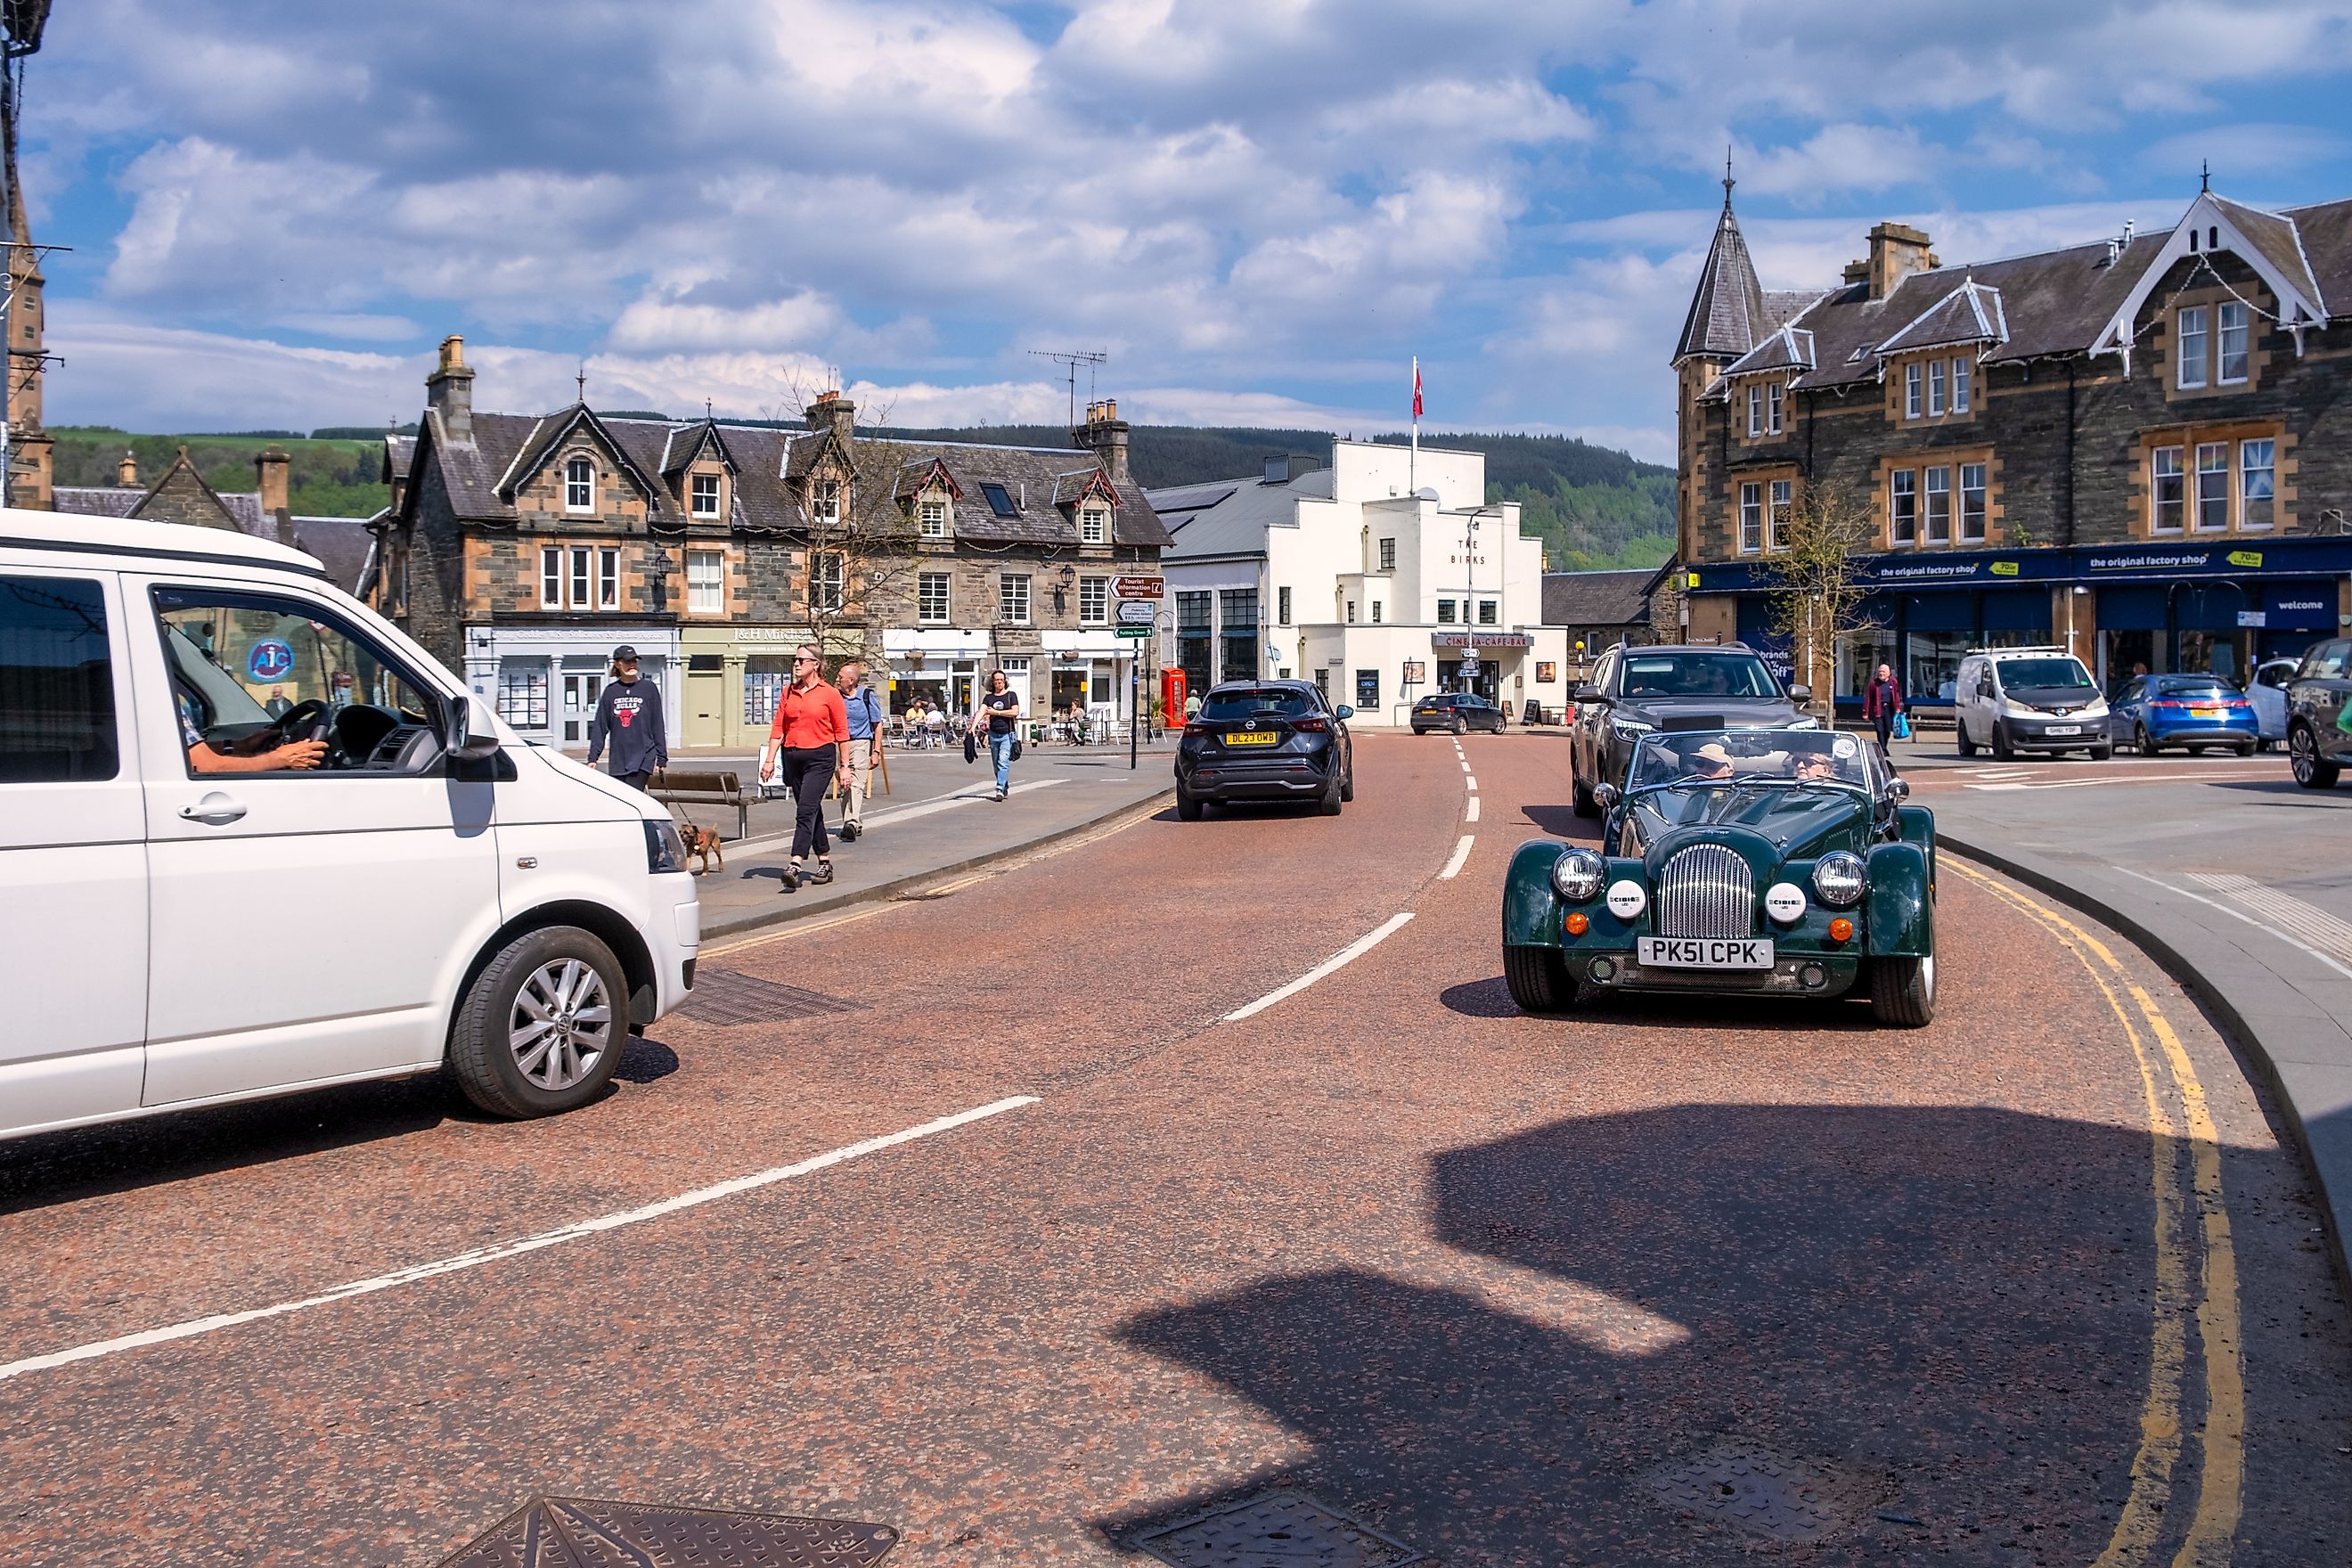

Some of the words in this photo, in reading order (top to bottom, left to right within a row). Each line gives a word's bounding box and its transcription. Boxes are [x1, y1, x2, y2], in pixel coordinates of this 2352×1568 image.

[1450, 554, 1485, 565] BIRKS
[2090, 559, 2106, 568] the
[2107, 557, 2145, 568] original
[2145, 555, 2180, 567] factory
[2181, 554, 2207, 565] shop
[1881, 568, 1894, 576] the
[1895, 567, 1925, 577] original
[1926, 566, 1955, 576] factory
[1956, 565, 1976, 576] shop
[2278, 600, 2323, 610] welcome
[733, 627, 760, 641] J&H
[764, 627, 814, 641] Mitchell
[1233, 734, 1255, 742] DL23
[1257, 733, 1274, 742] OWB
[1653, 941, 1703, 963] PK51
[1711, 942, 1758, 964] CPK
